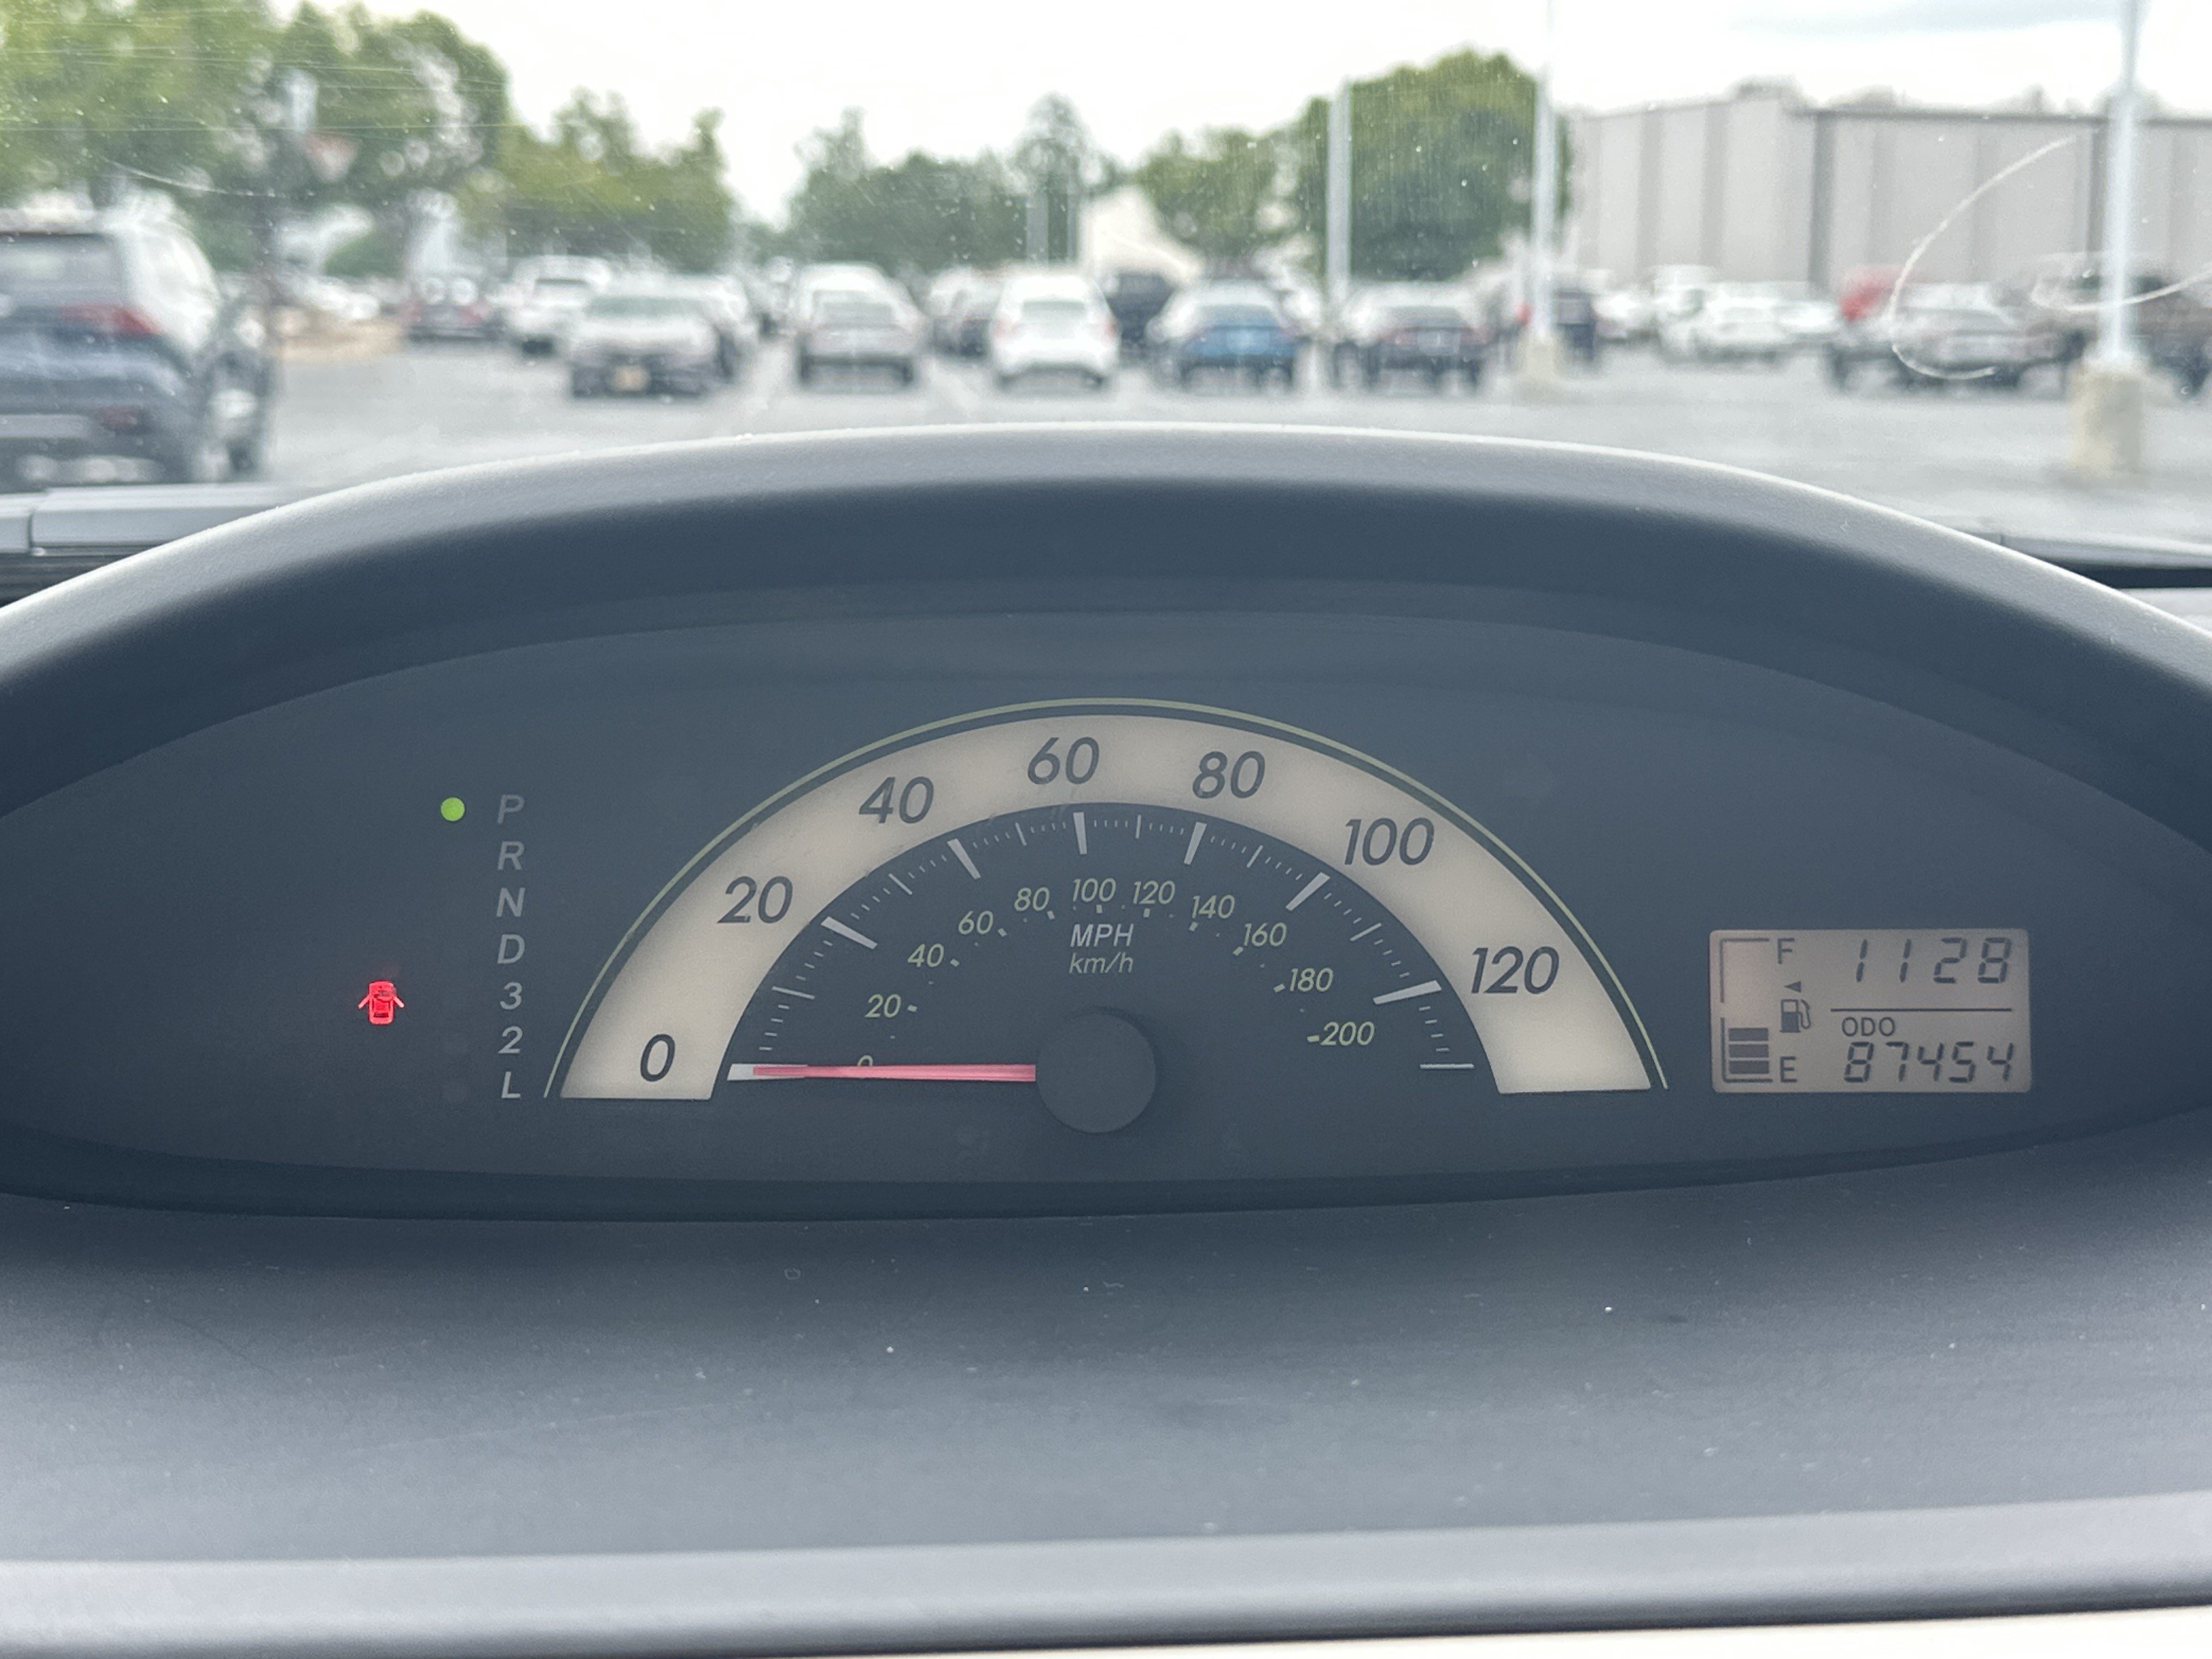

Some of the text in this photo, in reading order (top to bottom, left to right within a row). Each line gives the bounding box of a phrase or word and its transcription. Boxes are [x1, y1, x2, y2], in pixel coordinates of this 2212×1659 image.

[1028, 737, 1099, 785] 60
[1192, 751, 1265, 798] 80
[498, 794, 525, 823] P
[859, 776, 934, 823] 40
[1344, 817, 1435, 865] 100
[497, 841, 525, 871] R
[496, 887, 525, 917] N
[716, 876, 793, 924] 20
[1014, 887, 1050, 911] 80
[1072, 878, 1116, 902] 100
[1132, 881, 1175, 905] 120
[1191, 895, 1235, 919] 140
[958, 910, 994, 934] 60
[1070, 924, 1134, 947] MPH
[1243, 923, 1287, 946] 160
[497, 934, 525, 964] D
[907, 944, 945, 967] 40
[1069, 952, 1134, 974] km/h
[1777, 938, 1796, 964] F
[1856, 937, 2012, 984] 1128
[1289, 967, 1334, 992] 180
[1471, 946, 1560, 994] 120
[499, 982, 523, 1010] 3
[864, 994, 902, 1018] 20
[498, 1026, 523, 1054] 2
[1319, 1022, 1375, 1046] 200
[1842, 1016, 1895, 1037] ODO
[640, 1034, 675, 1082] 0
[1780, 1056, 1798, 1083] E
[1844, 1041, 2014, 1083] 87454
[501, 1071, 521, 1099] L
